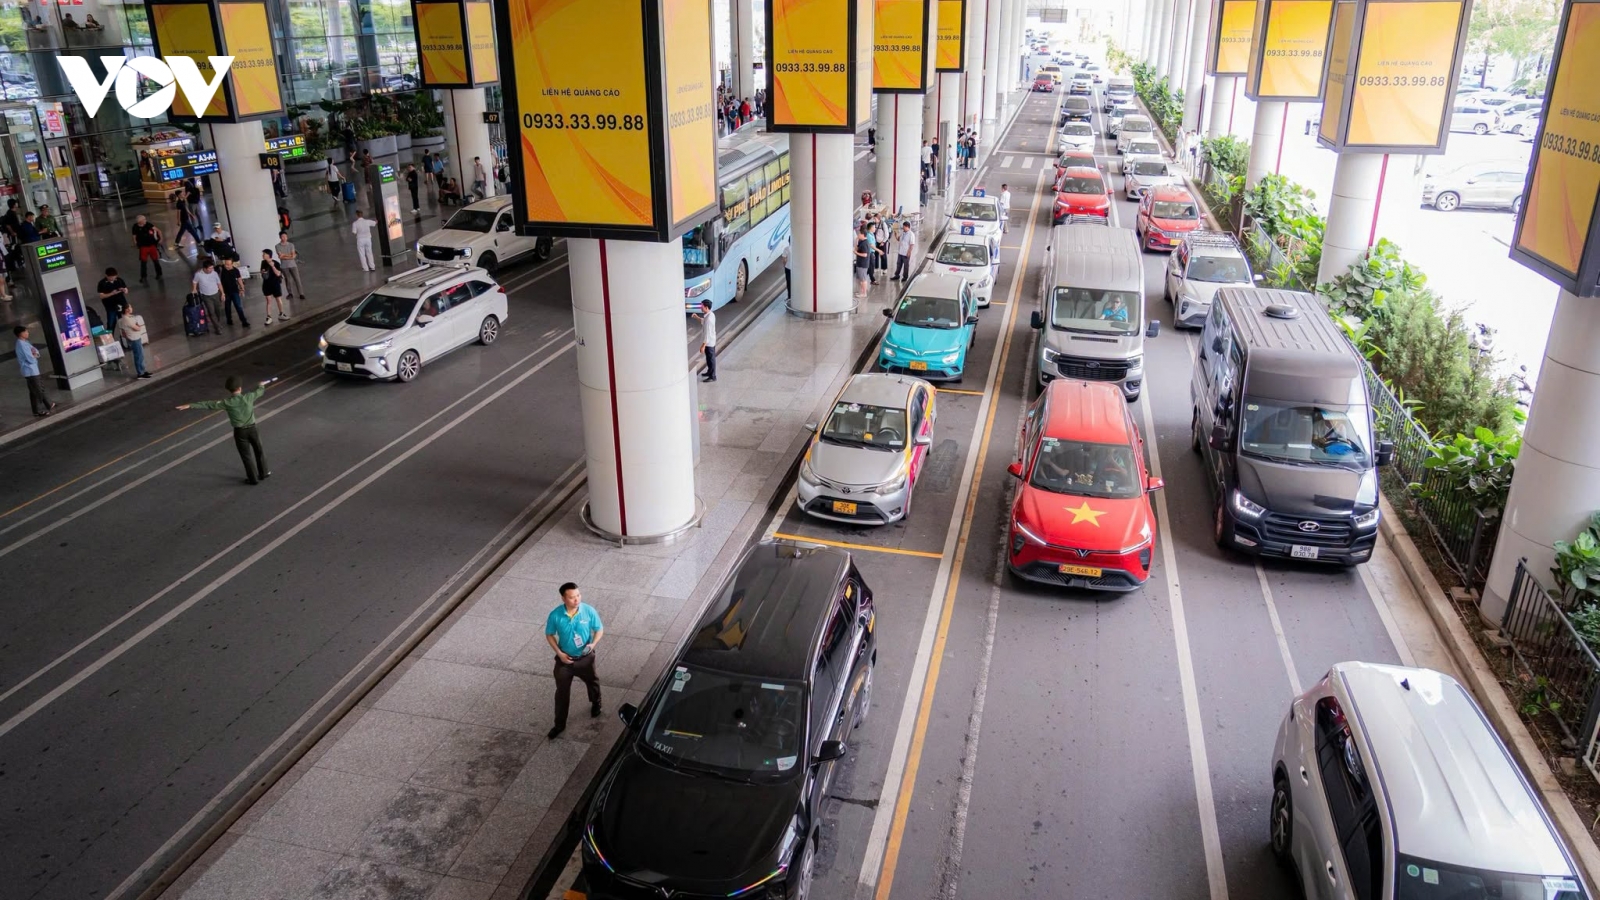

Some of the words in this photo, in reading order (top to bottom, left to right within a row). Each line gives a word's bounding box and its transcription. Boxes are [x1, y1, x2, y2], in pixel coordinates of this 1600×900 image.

[776, 63, 846, 72] 0933.33.99.88
[1360, 76, 1445, 86] 0933.33.99.88
[542, 87, 559, 96] LIÊN
[561, 87, 571, 97] HỆ
[574, 86, 601, 96] QUẢNG
[524, 113, 644, 131] 0933.33.99.88
[267, 157, 278, 166] 08
